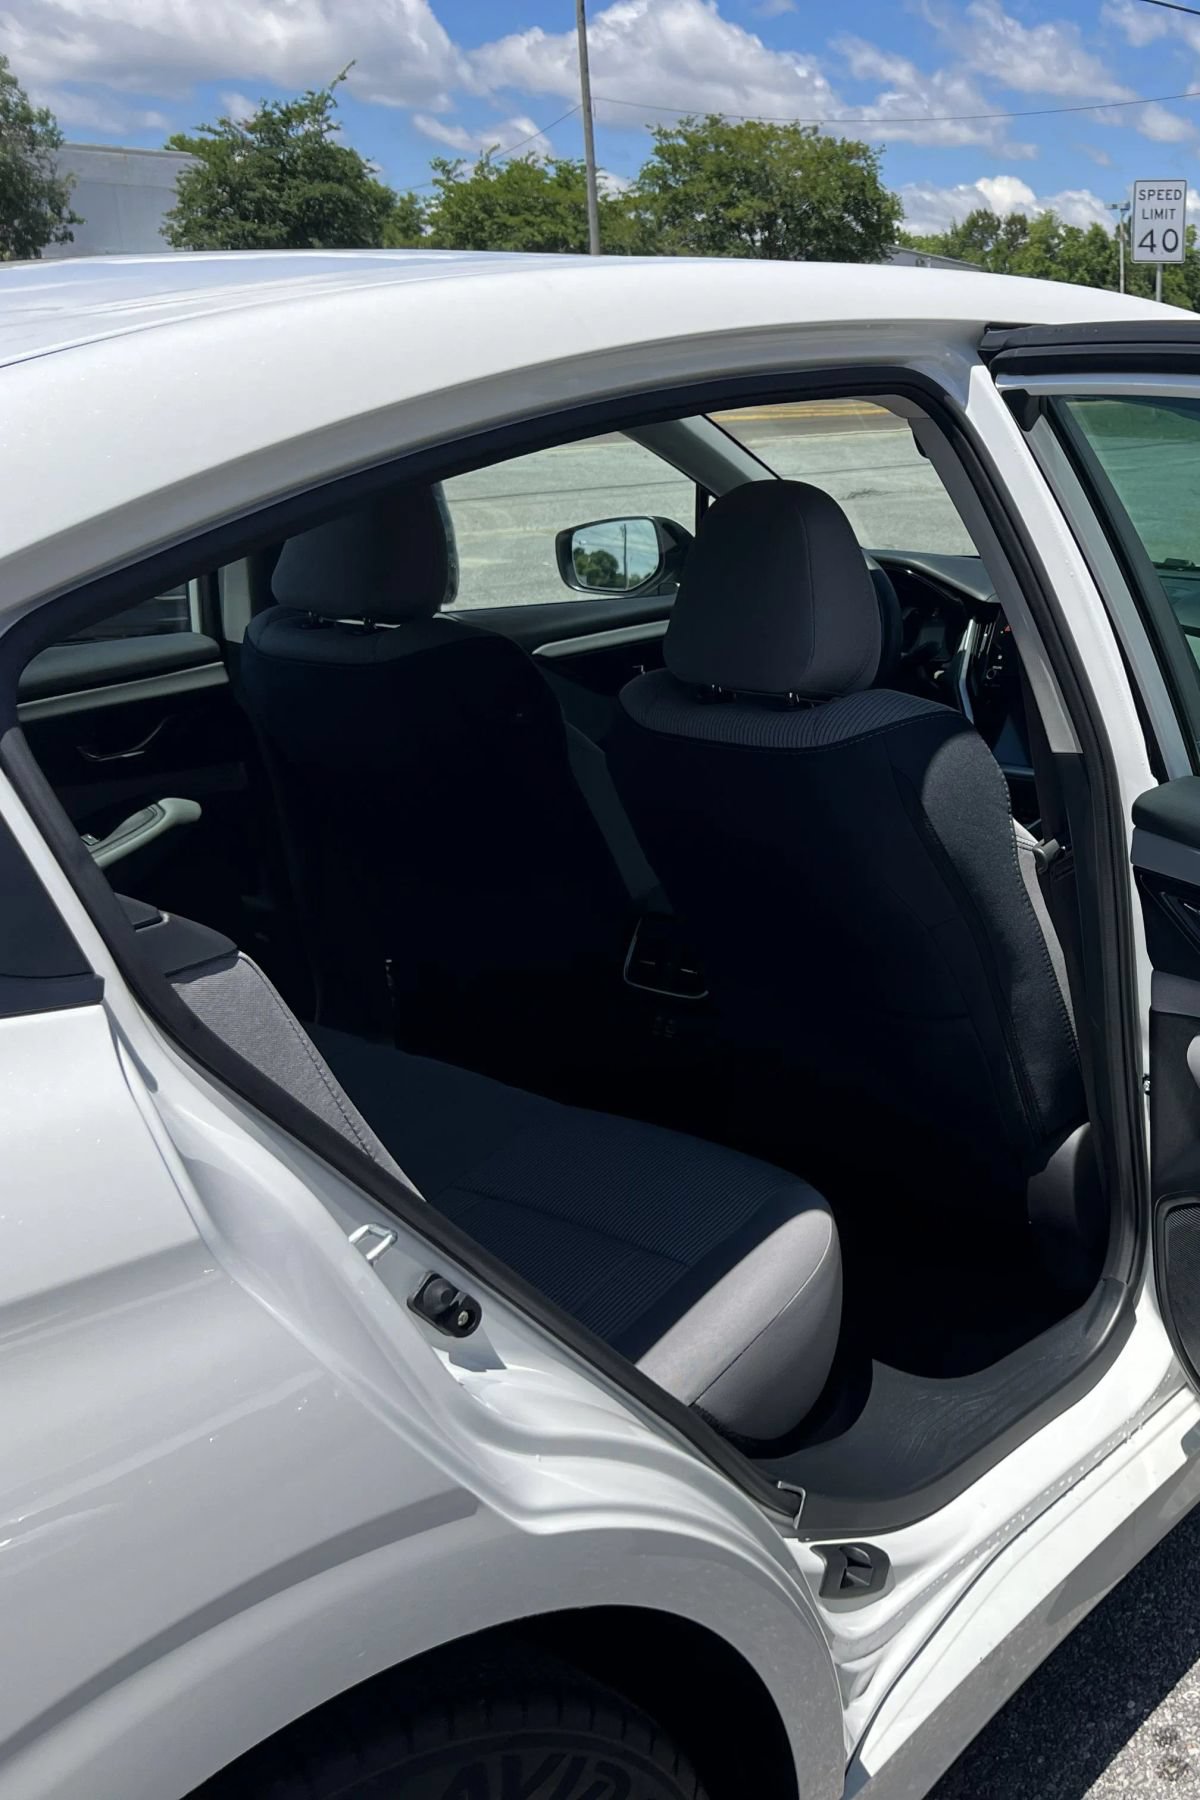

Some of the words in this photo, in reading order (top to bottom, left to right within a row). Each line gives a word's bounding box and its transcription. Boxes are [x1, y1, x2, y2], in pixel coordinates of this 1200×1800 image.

[1138, 189, 1182, 200] SPEED
[1142, 208, 1176, 220] LIMIT
[1138, 228, 1179, 253] 40
